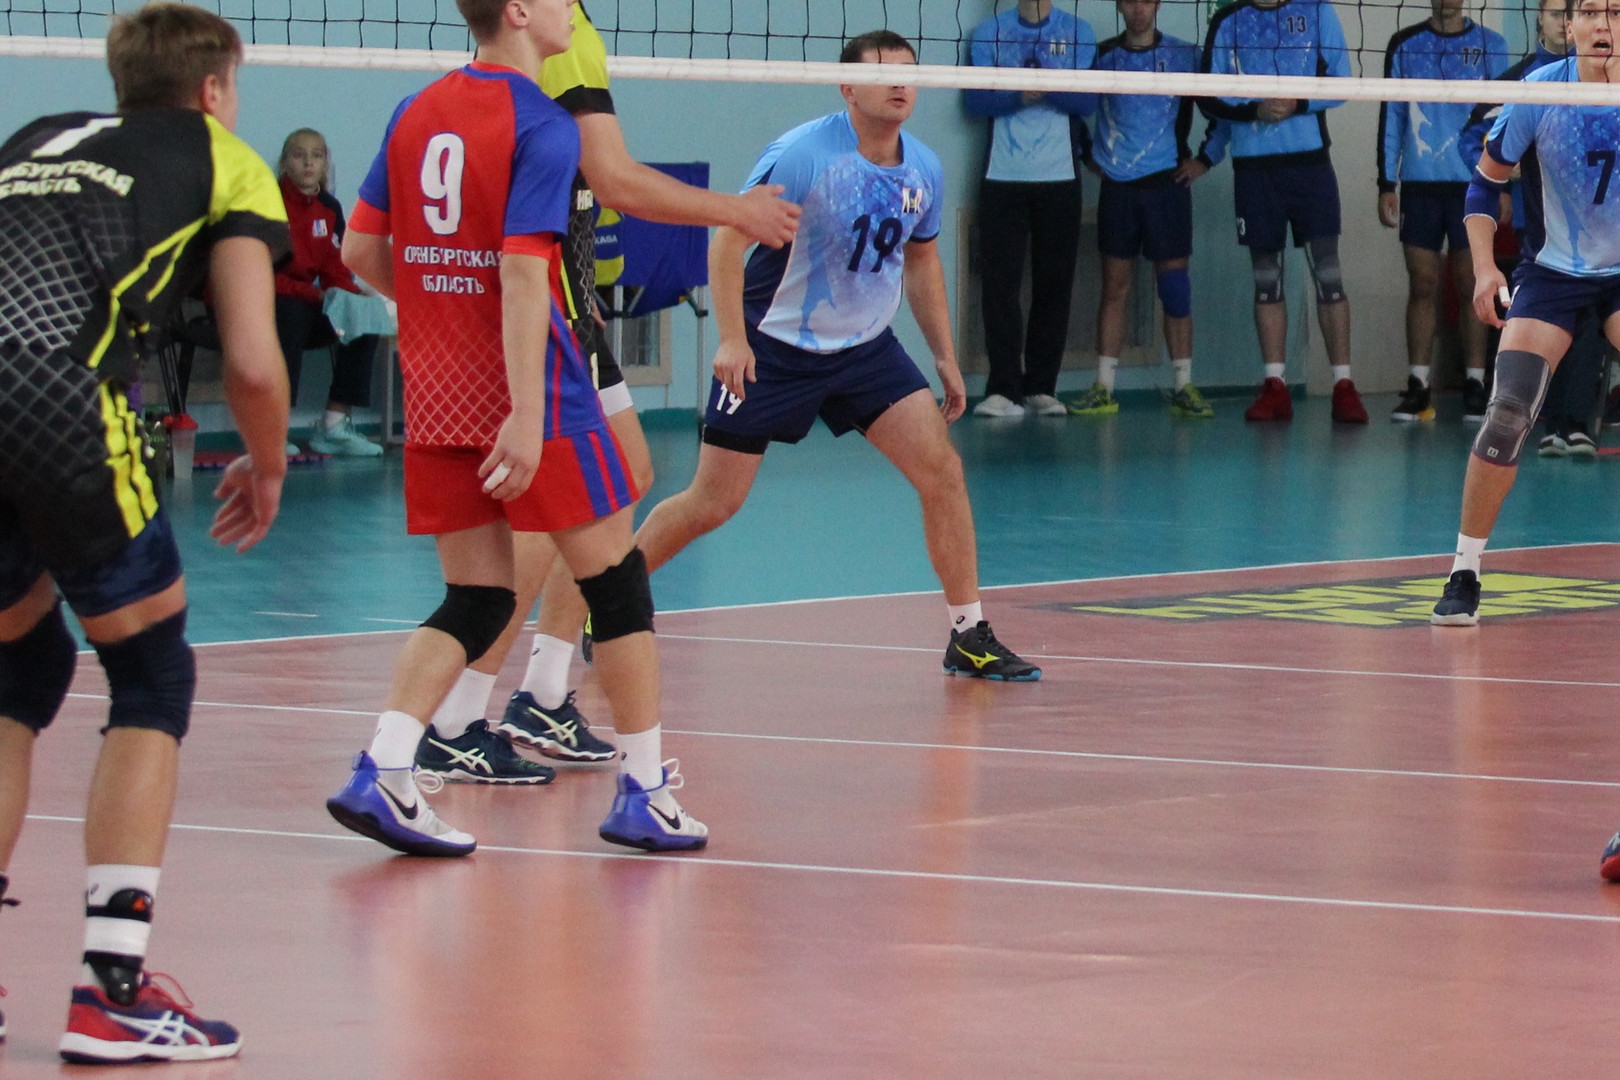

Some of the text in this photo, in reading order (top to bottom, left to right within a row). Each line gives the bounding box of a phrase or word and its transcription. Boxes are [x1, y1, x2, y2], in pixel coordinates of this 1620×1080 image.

[1286, 15, 1307, 34] 13
[1462, 47, 1482, 66] 17
[420, 131, 465, 236] 9
[1587, 149, 1617, 206] 7
[847, 214, 904, 273] 19
